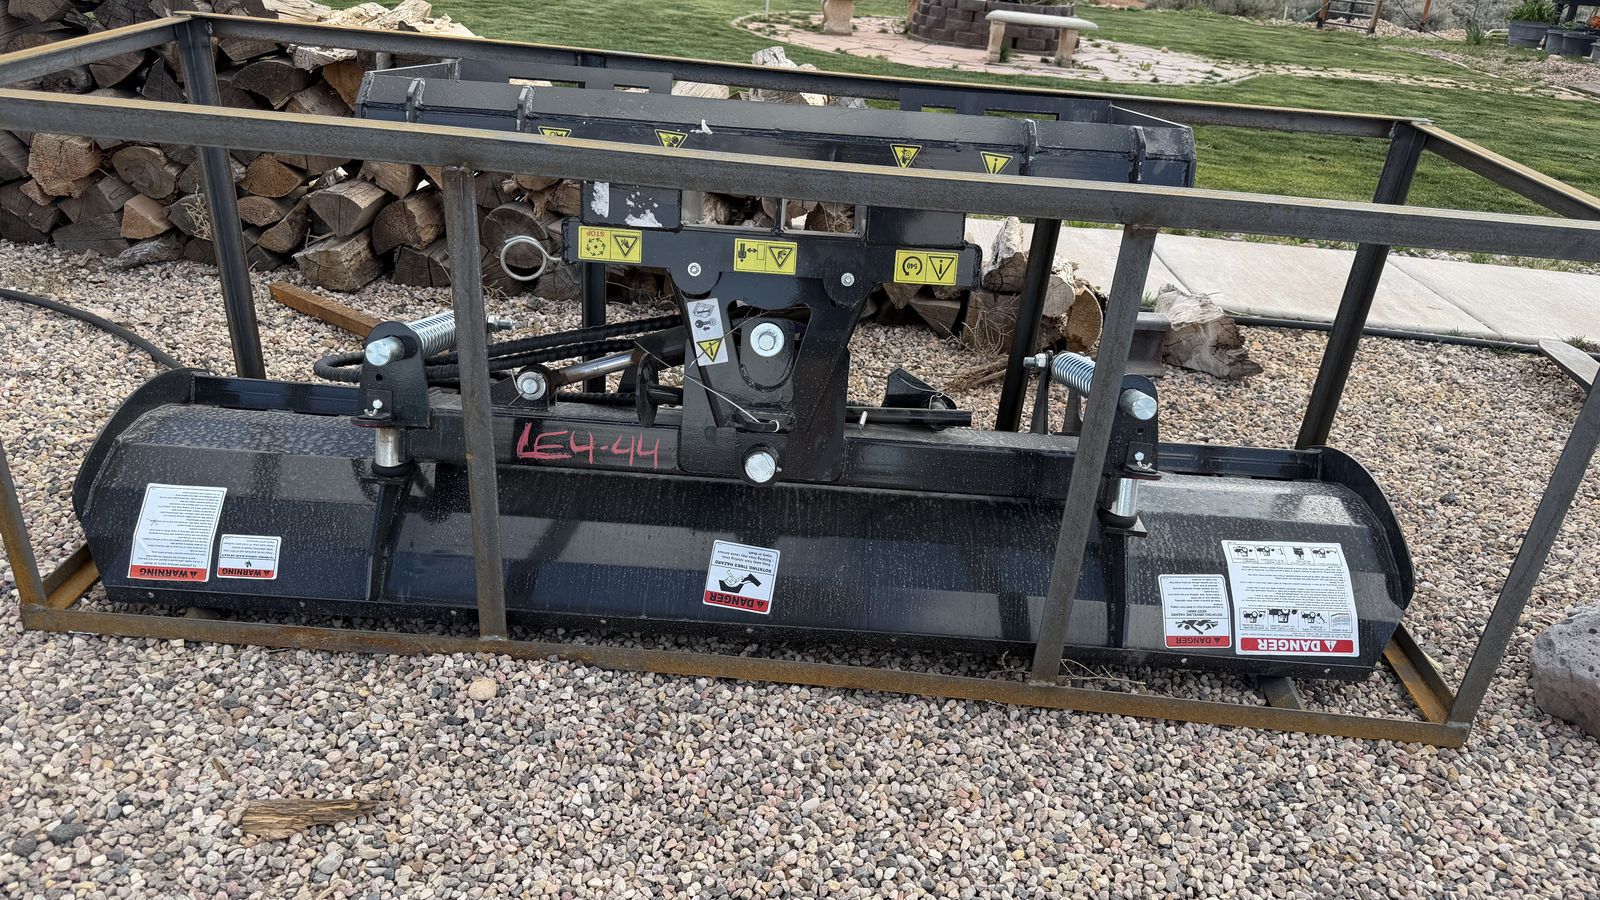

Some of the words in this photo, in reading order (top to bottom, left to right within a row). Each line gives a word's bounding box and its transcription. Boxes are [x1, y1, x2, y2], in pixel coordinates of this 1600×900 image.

[906, 262, 918, 270] 540
[139, 568, 188, 578] WARNING
[222, 568, 261, 576] WARNING
[748, 565, 772, 573] ROTATING
[709, 592, 755, 608] DANGER
[1257, 639, 1321, 652] DANGER
